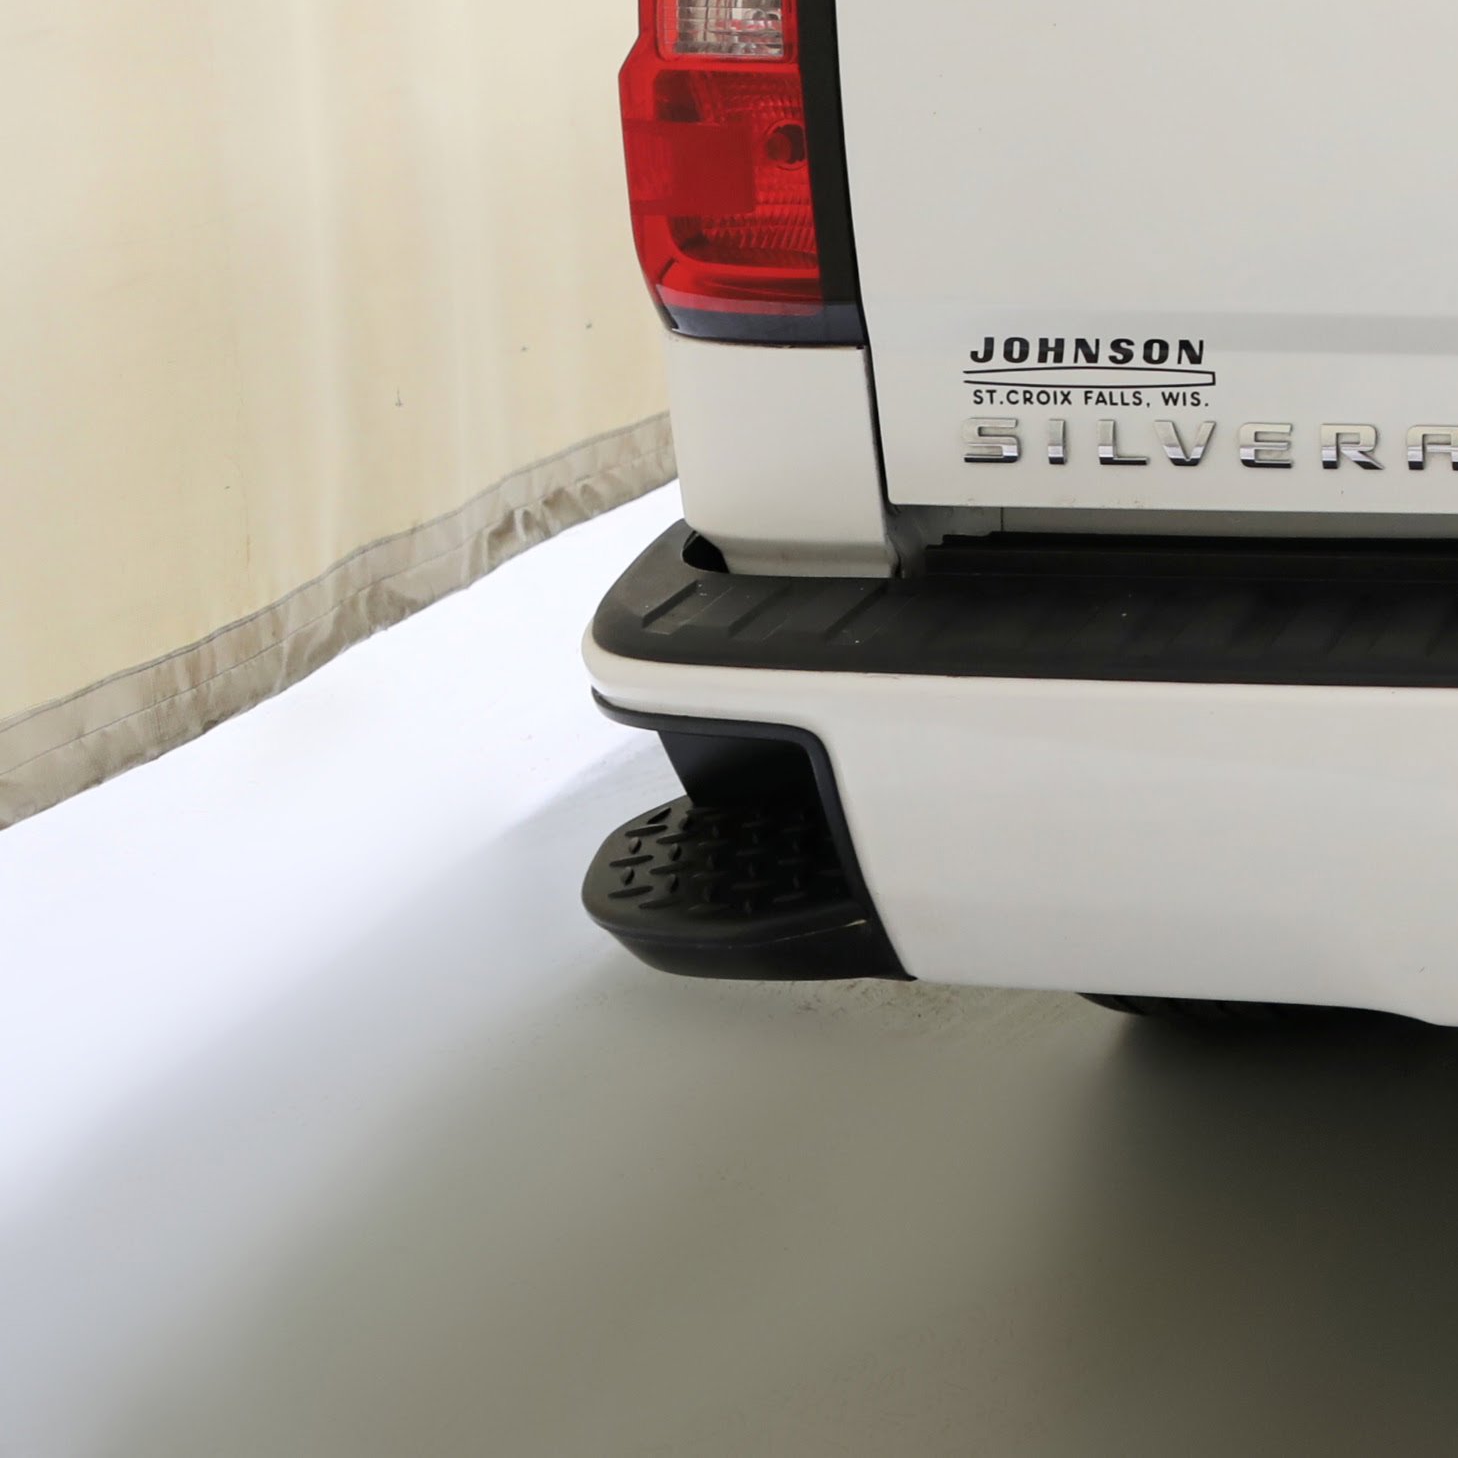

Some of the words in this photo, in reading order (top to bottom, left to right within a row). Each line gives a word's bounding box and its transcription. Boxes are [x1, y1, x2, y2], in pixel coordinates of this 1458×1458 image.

[970, 337, 1205, 365] JOHNSON
[973, 389, 1072, 406] ST.CROIX
[1084, 390, 1150, 408] FALLS,
[1161, 391, 1209, 407] WIS.
